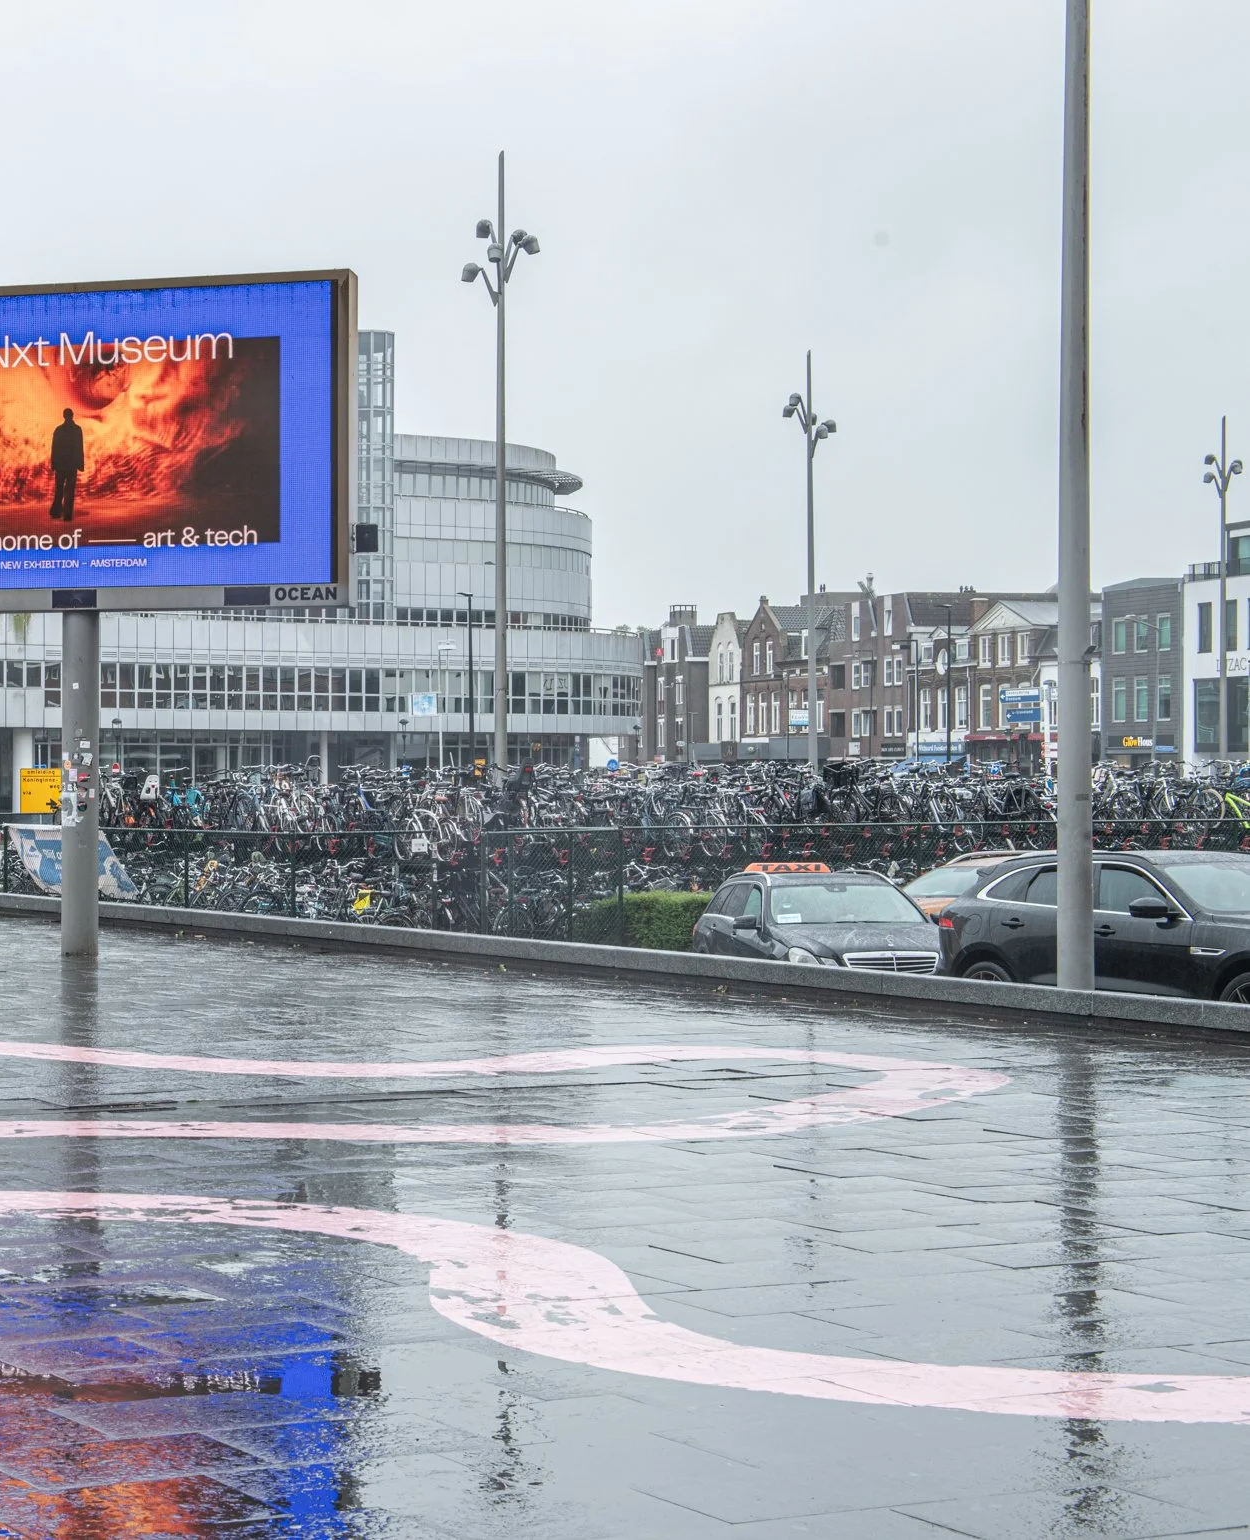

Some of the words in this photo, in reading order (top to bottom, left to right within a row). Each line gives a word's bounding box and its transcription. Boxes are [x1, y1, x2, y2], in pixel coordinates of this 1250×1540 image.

[59, 330, 234, 366] Museum
[57, 528, 83, 551] of
[143, 529, 176, 549] art
[180, 526, 200, 548] &
[204, 524, 258, 547] tech
[0, 560, 22, 570] NEW
[23, 559, 80, 570] EXHIBITION
[89, 557, 148, 569] AMSTERDAM
[274, 586, 338, 601] OCEAN
[756, 863, 822, 872] TAXI
